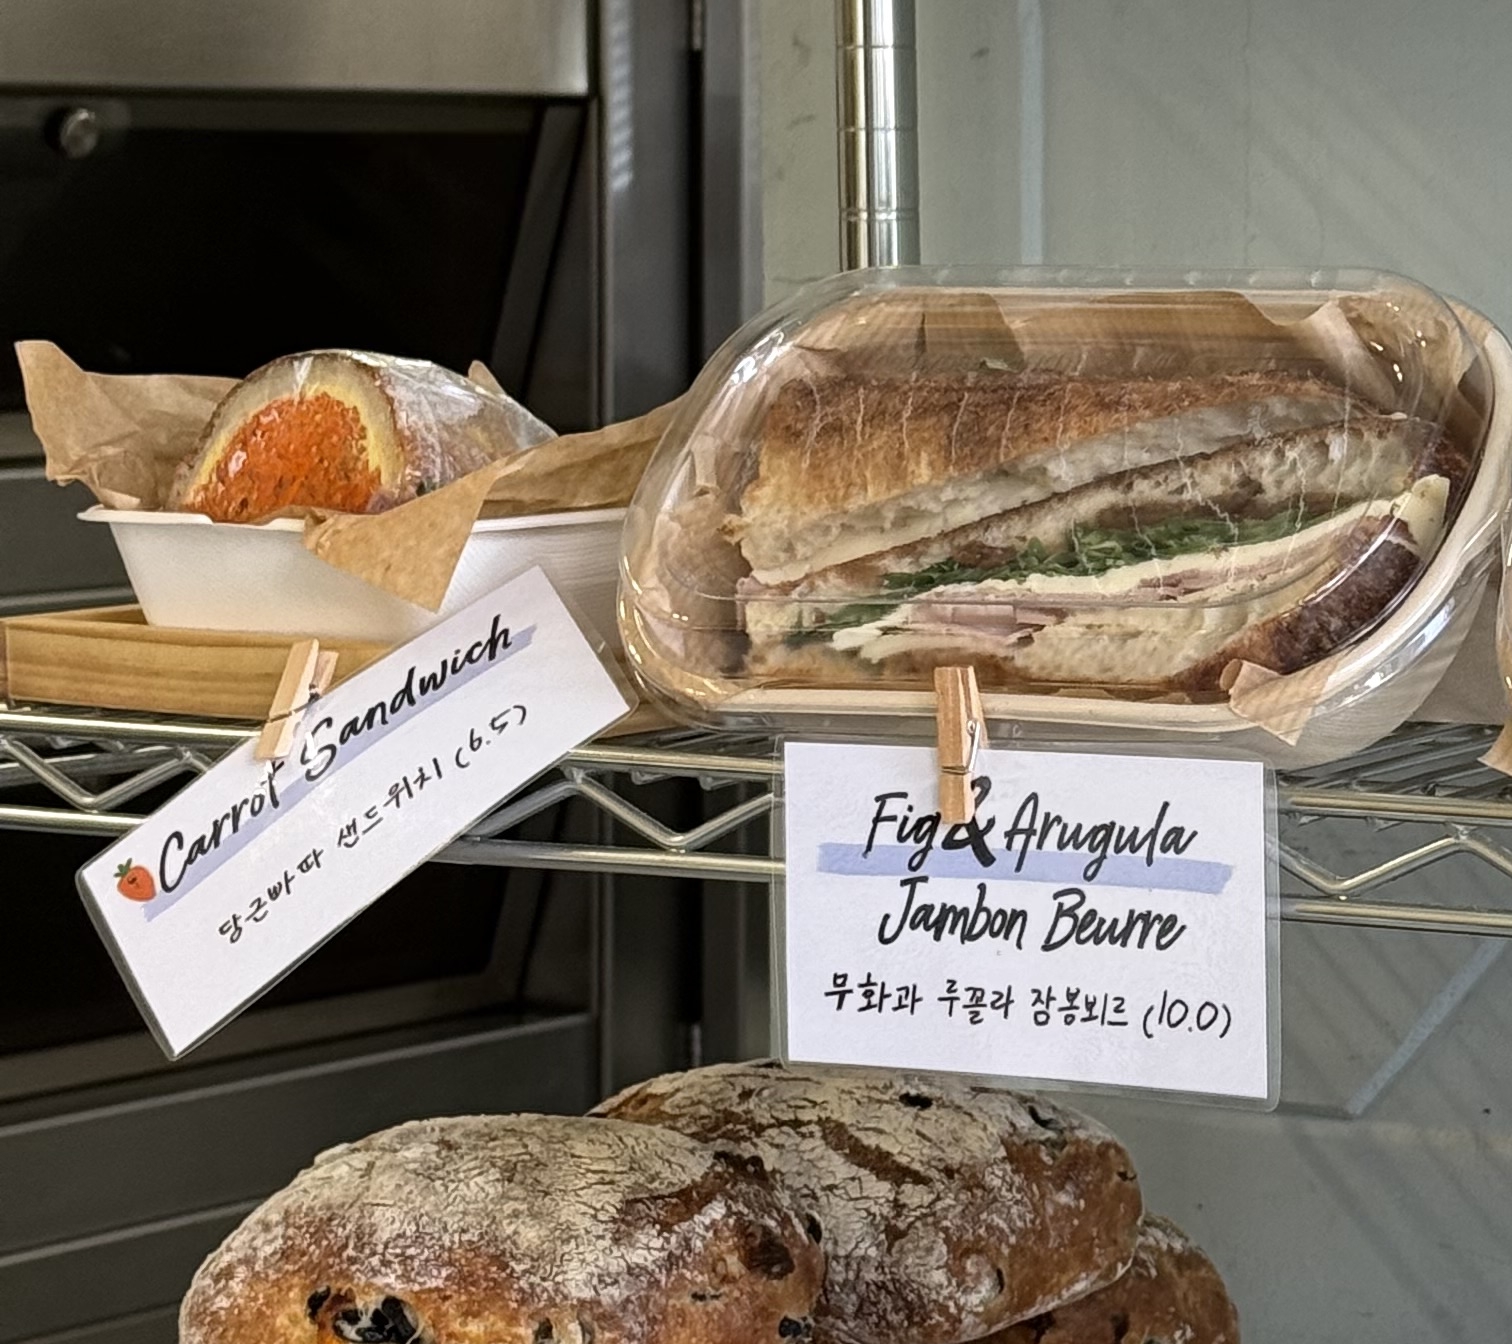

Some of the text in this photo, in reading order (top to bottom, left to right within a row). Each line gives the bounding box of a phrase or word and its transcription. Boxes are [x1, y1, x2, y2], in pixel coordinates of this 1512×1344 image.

[159, 614, 513, 893] Carrot Sandwich
[337, 757, 443, 848] 샌드위치
[455, 704, 527, 769] (6.5)
[862, 775, 1199, 882] Fig & Arugula
[877, 875, 1188, 953] Jambon Beurre
[824, 971, 1233, 1039] 무화과 루꼴라 잠봉뵈르 (10.0)
